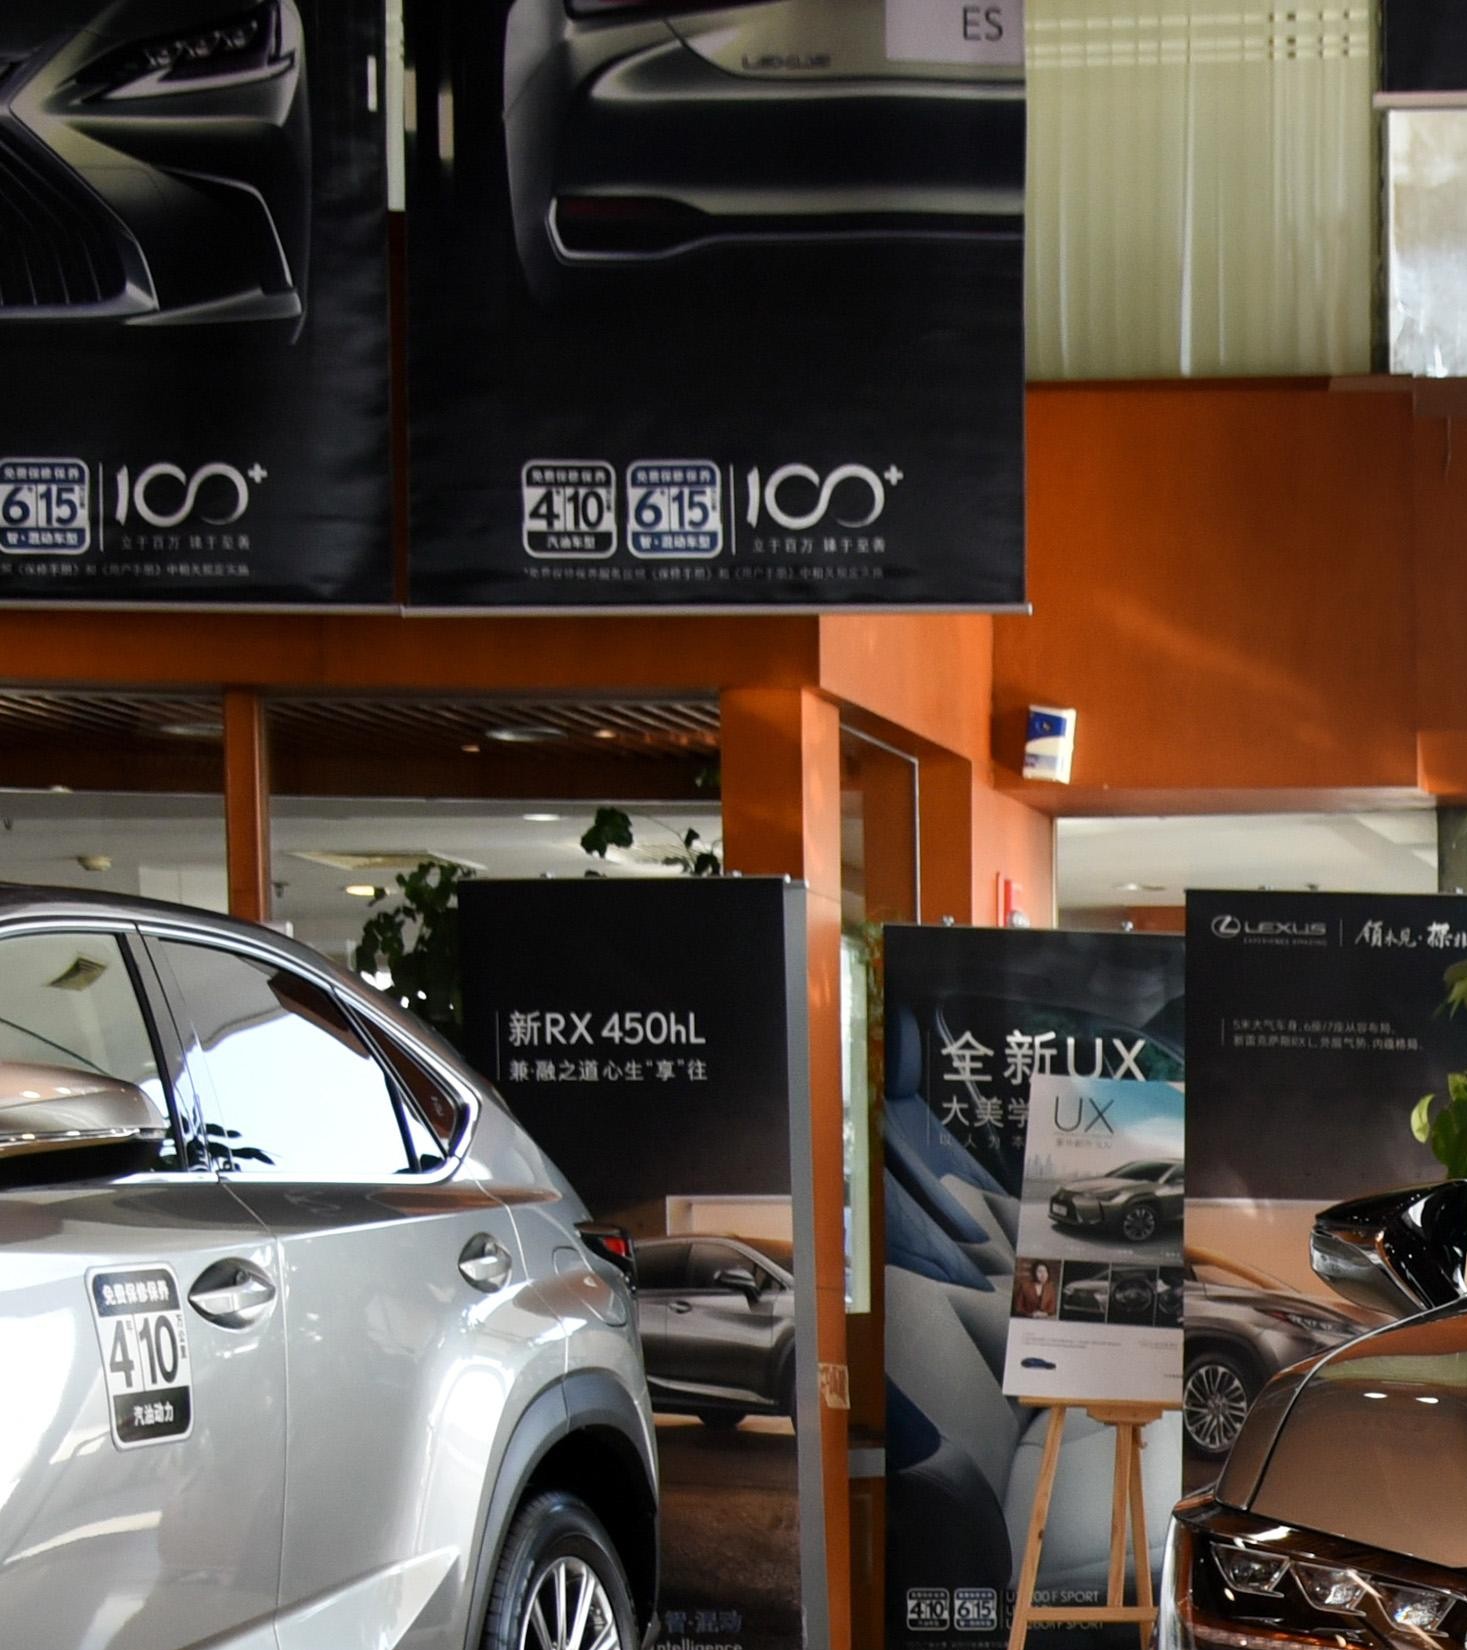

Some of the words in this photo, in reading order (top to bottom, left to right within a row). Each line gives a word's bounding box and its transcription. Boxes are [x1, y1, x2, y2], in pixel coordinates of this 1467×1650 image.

[962, 7, 1003, 41] ES
[39, 486, 78, 526] 15
[529, 489, 560, 529] 4
[567, 490, 604, 530] 10
[672, 489, 710, 529] 15
[1245, 920, 1327, 936] LEXUS
[508, 1010, 594, 1046] 新RX
[601, 1011, 706, 1045] 450hL
[941, 1029, 1147, 1085] 全新UX
[1054, 1096, 1114, 1134] UX
[110, 1319, 135, 1389] 4
[138, 1315, 180, 1385] 10
[133, 1401, 175, 1427] 汽油动力
